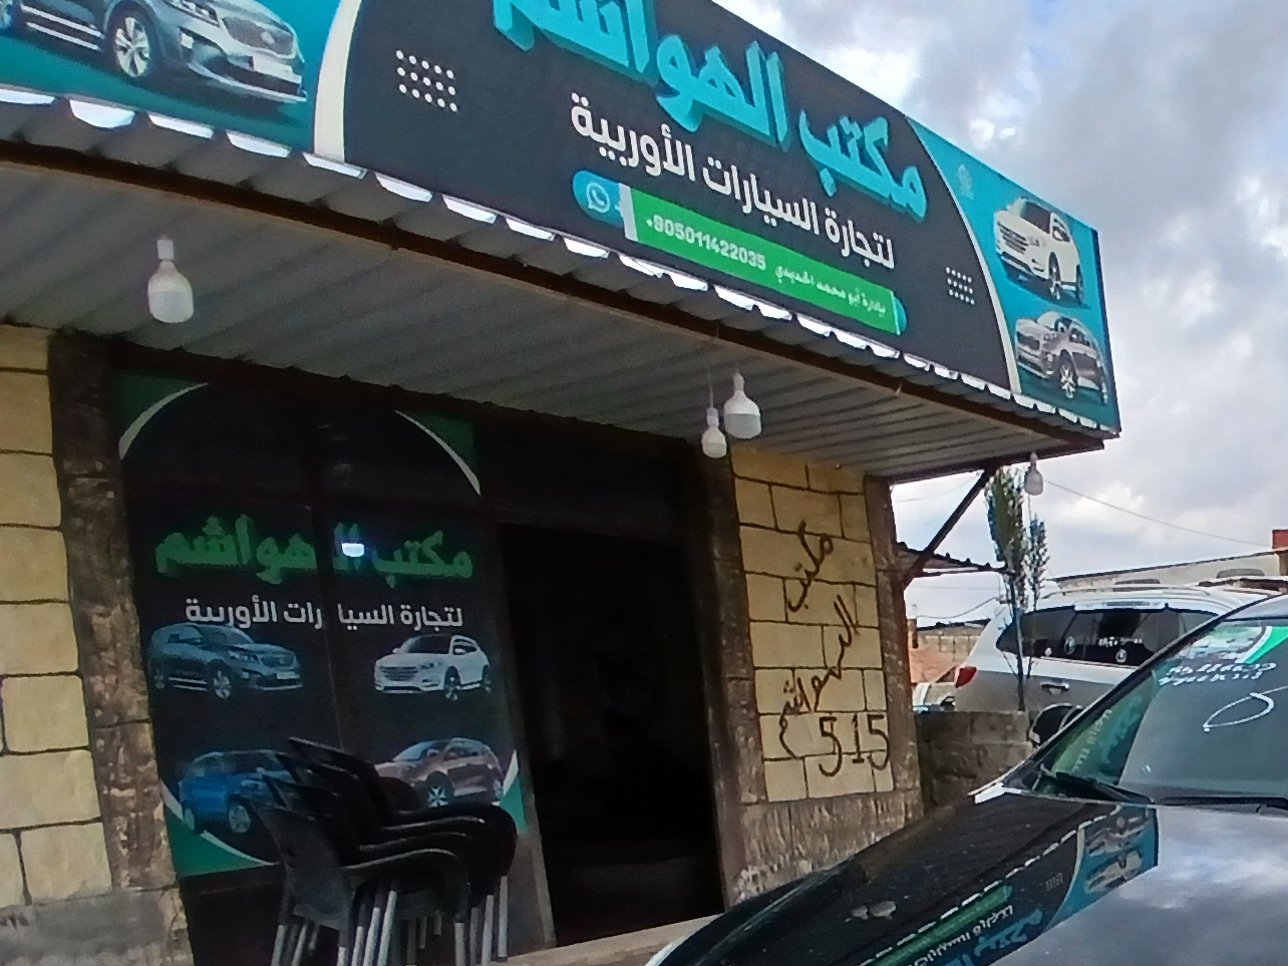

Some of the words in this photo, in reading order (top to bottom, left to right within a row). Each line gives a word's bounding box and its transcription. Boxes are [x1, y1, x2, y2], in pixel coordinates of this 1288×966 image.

[571, 92, 696, 182] الأوربية
[800, 110, 927, 222] مكتب
[702, 156, 820, 235] السيارات
[825, 206, 895, 269] لتجارة
[372, 530, 474, 588] مكتب
[400, 603, 464, 631] لتجارة
[818, 714, 890, 777] 515
